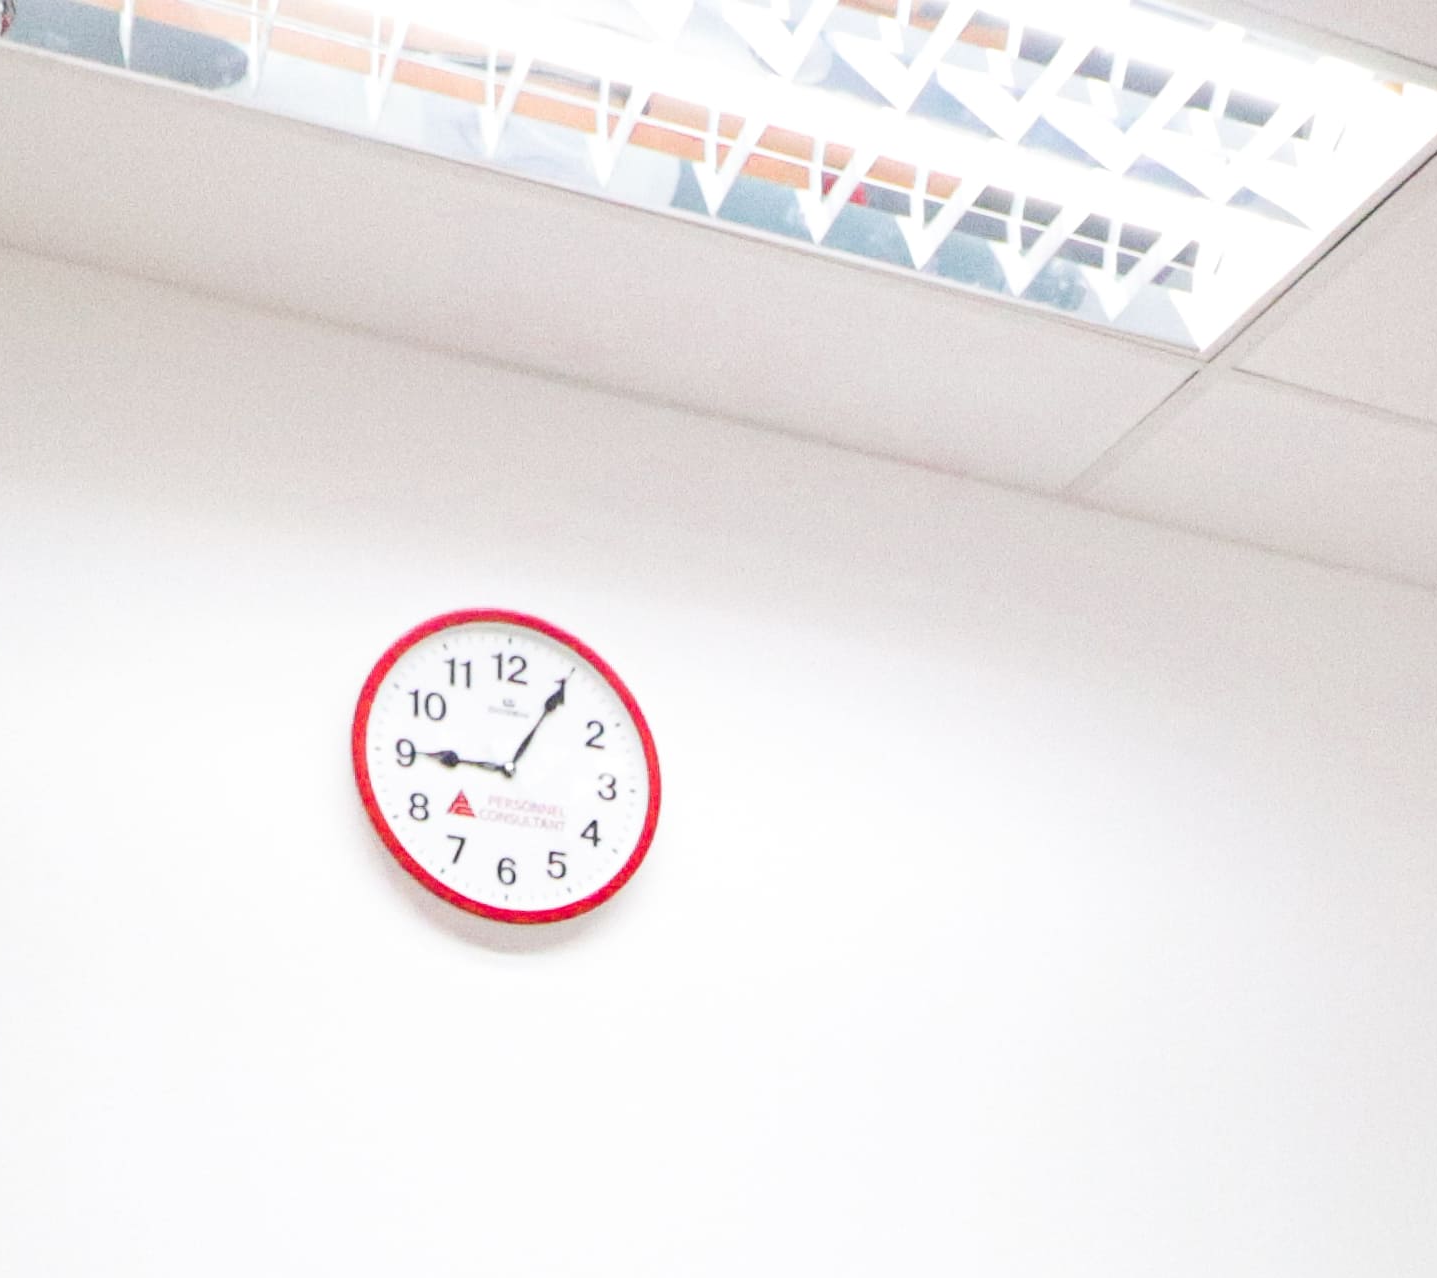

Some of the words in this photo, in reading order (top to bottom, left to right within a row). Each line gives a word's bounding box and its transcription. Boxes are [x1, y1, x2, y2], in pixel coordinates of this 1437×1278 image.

[445, 657, 472, 689] 11
[492, 652, 528, 686] 12
[409, 689, 447, 722] 10
[585, 720, 605, 750] 2
[395, 738, 416, 767] 9
[597, 775, 617, 801] 3
[408, 792, 430, 822] 8
[580, 819, 602, 848] 4
[447, 834, 466, 865] 7
[496, 857, 517, 886] 6
[546, 850, 567, 880] 5
